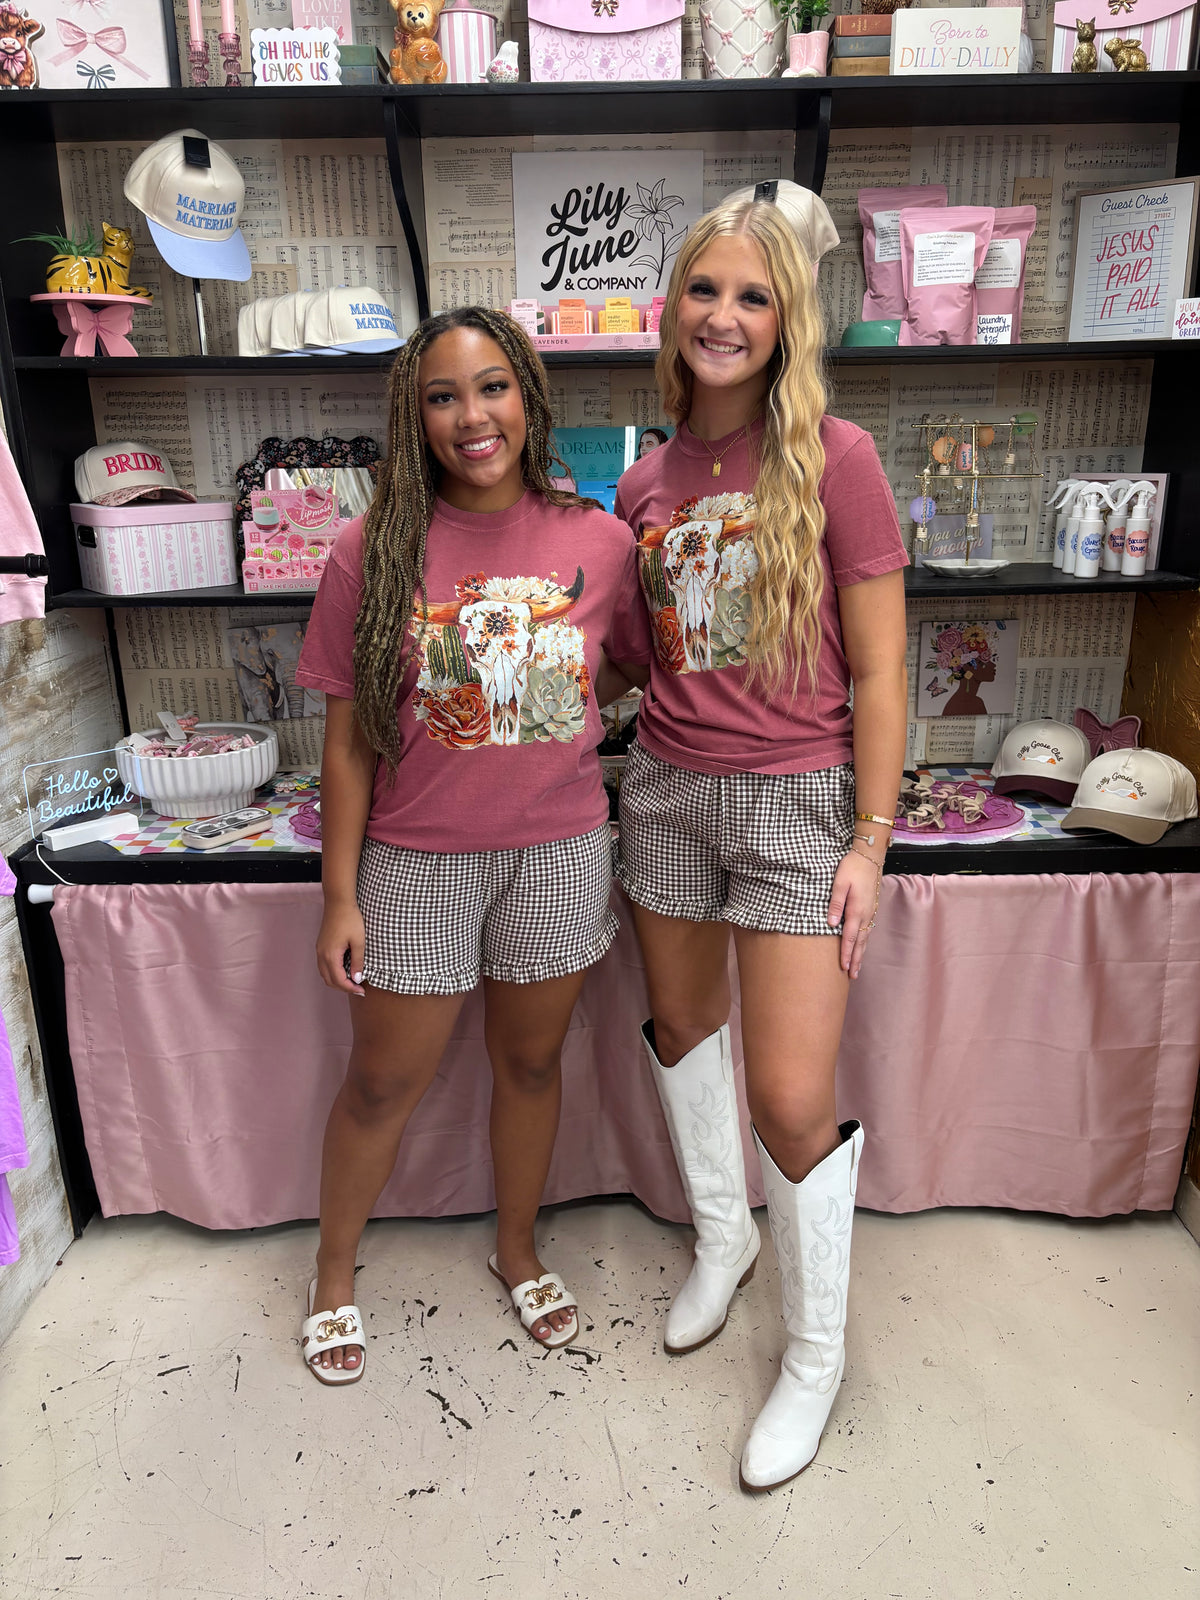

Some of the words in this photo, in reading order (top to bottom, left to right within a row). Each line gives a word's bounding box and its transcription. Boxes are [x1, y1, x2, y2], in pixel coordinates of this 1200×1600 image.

[302, 0, 342, 13] LOVE
[305, 16, 339, 28] LIKE
[930, 20, 973, 45] Born
[975, 24, 989, 39] to
[259, 41, 278, 60] OH
[900, 46, 1017, 68] DILLY-DALLY
[176, 193, 237, 216] MARRIAGE
[546, 182, 631, 237] Lily
[1101, 198, 1133, 213] Guest
[1135, 192, 1169, 209] Check
[176, 210, 234, 231] MATERIAL
[1096, 224, 1160, 263] JESUS
[540, 229, 640, 292] June
[564, 277, 575, 290] &
[577, 276, 648, 290] COMPANY
[1105, 256, 1153, 291] PAID
[1100, 293, 1122, 320] IT
[1126, 283, 1161, 314] ALL
[1180, 302, 1195, 312] YOU
[977, 324, 1010, 337] Detergent
[978, 315, 1006, 329] Laundry
[1175, 311, 1200, 329] doin
[561, 441, 626, 455] DREAMS
[103, 452, 165, 477] BRIDE
[1130, 545, 1146, 553] Rouge
[1031, 740, 1051, 750] Goose
[1051, 747, 1064, 762] Club
[44, 769, 102, 798] Hello
[1111, 771, 1133, 783] Goose
[1133, 781, 1147, 797] Club
[37, 782, 134, 823] Beautiful
